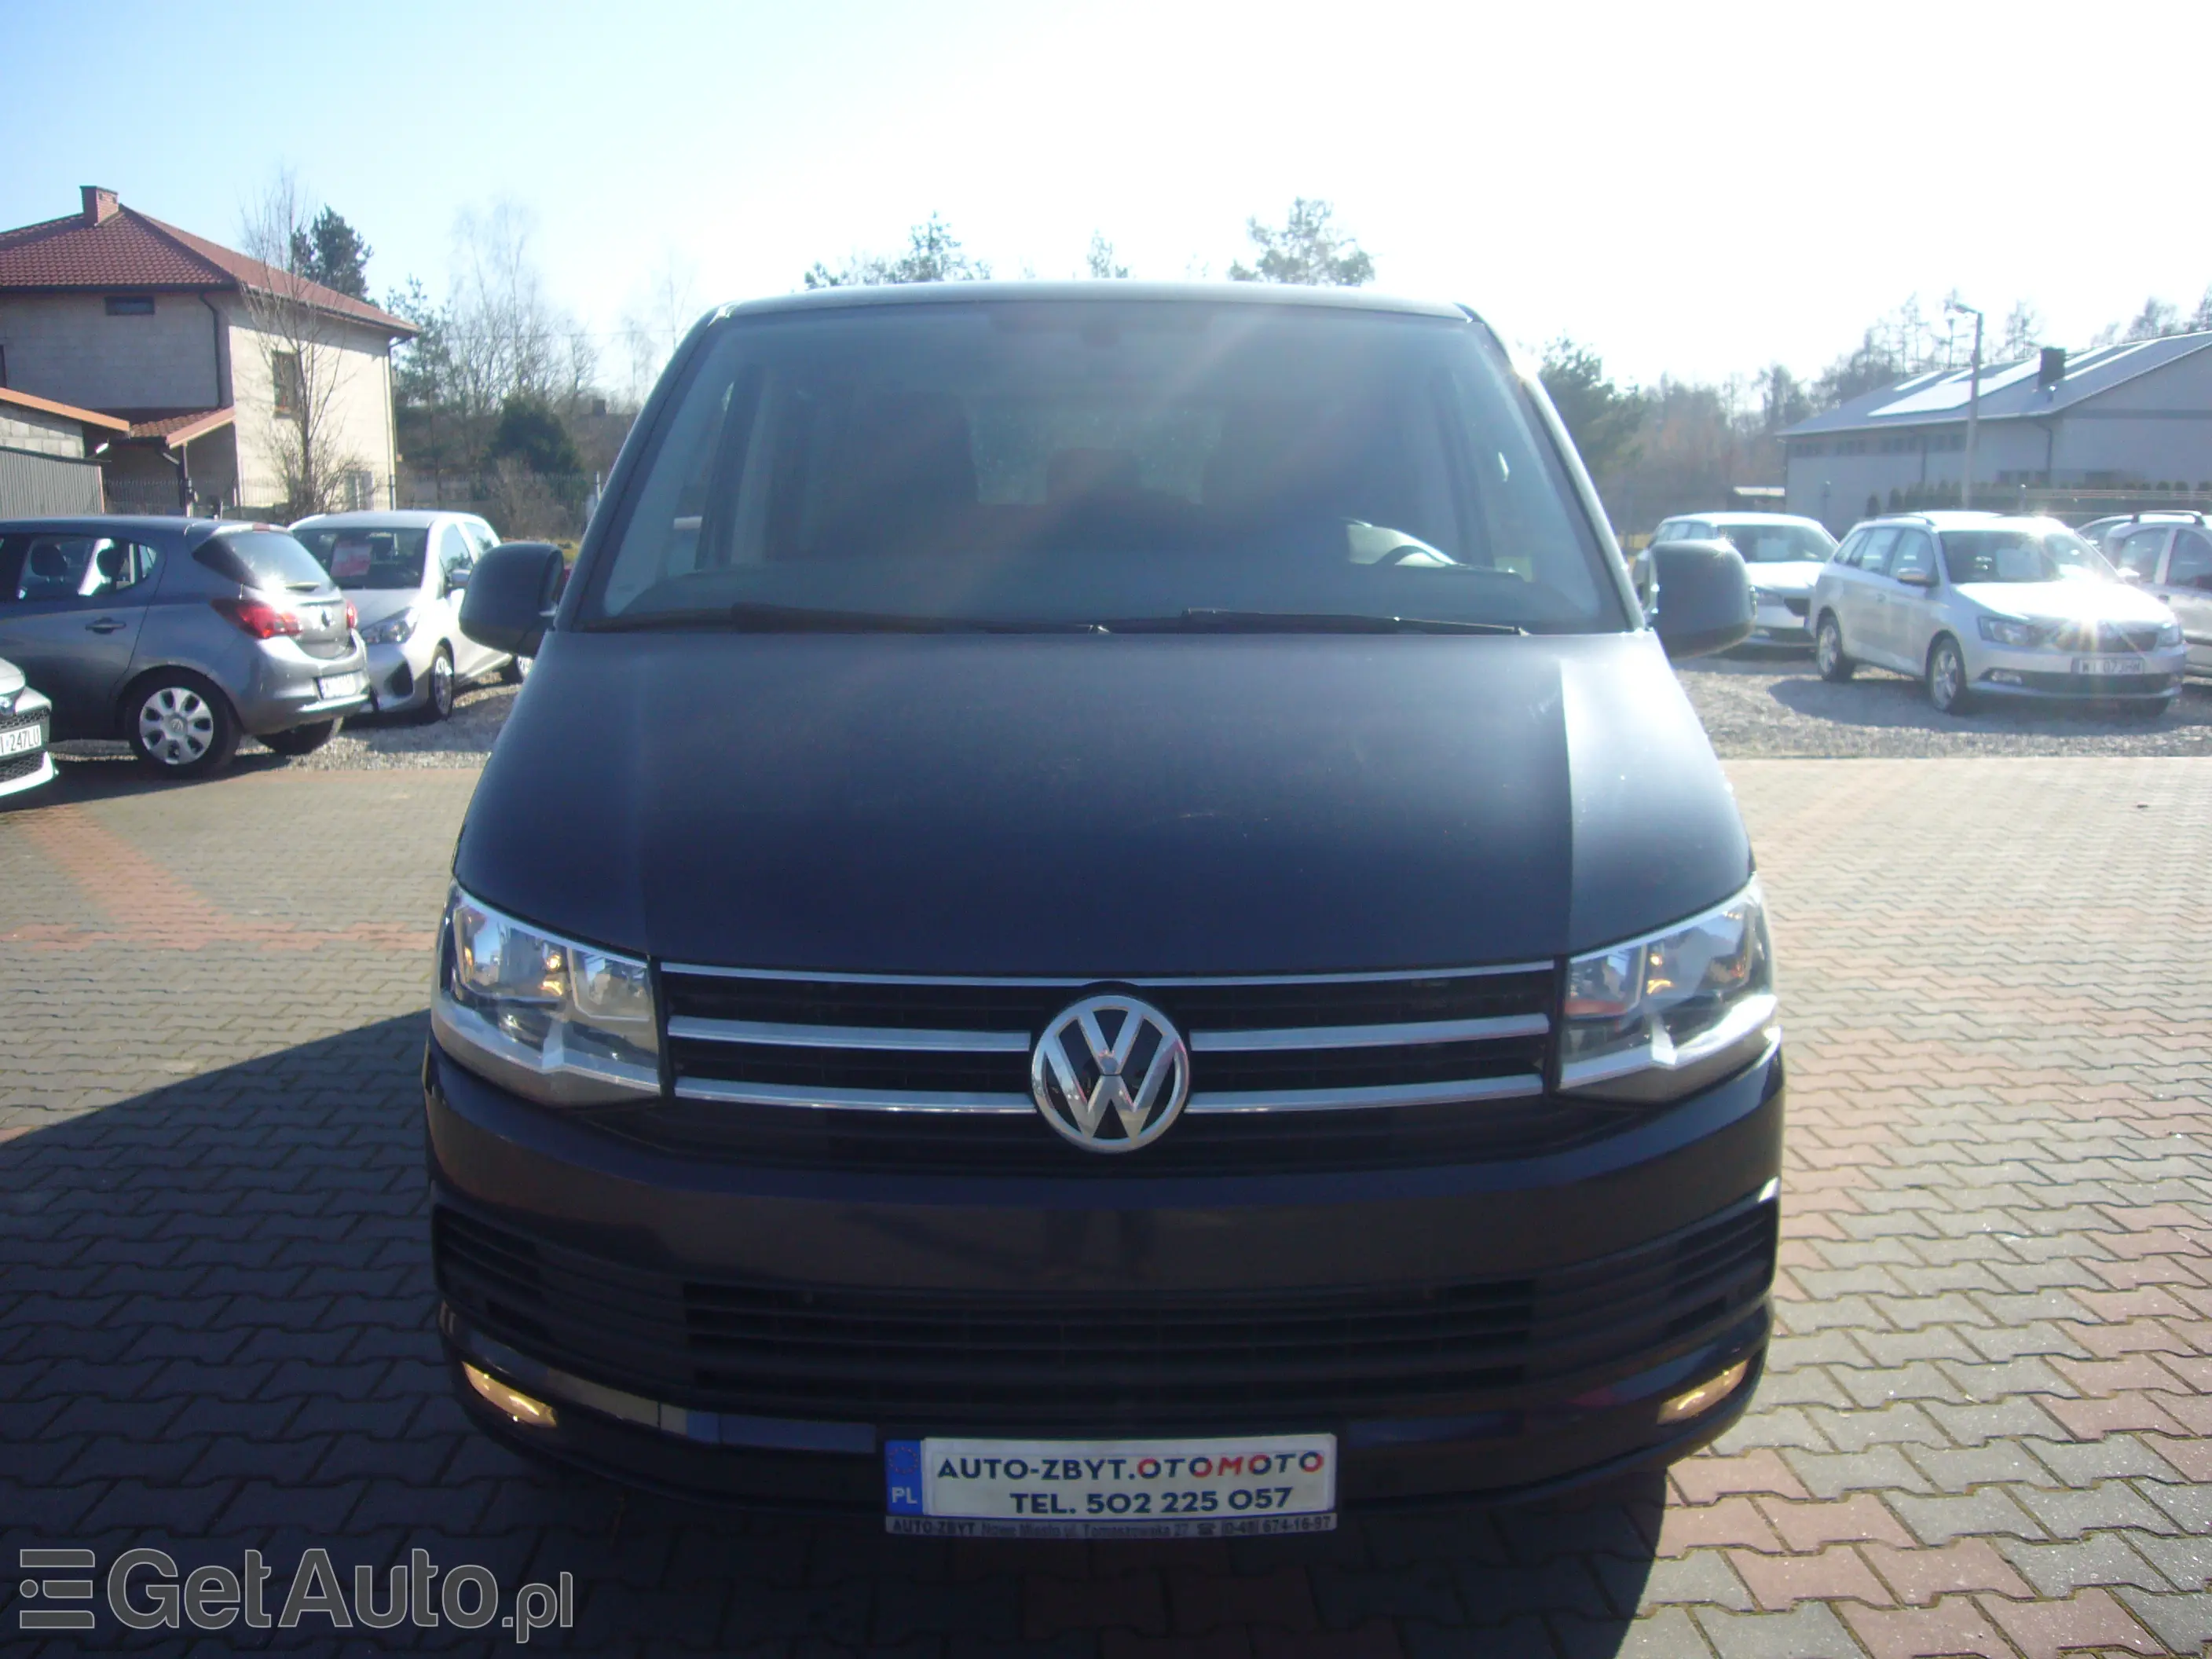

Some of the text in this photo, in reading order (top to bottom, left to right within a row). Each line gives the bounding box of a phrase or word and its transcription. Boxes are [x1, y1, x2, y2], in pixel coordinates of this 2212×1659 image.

[9, 727, 40, 752] 247LU
[892, 1486, 918, 1504] PL
[1009, 1486, 1293, 1514] TEL. 502 225 057
